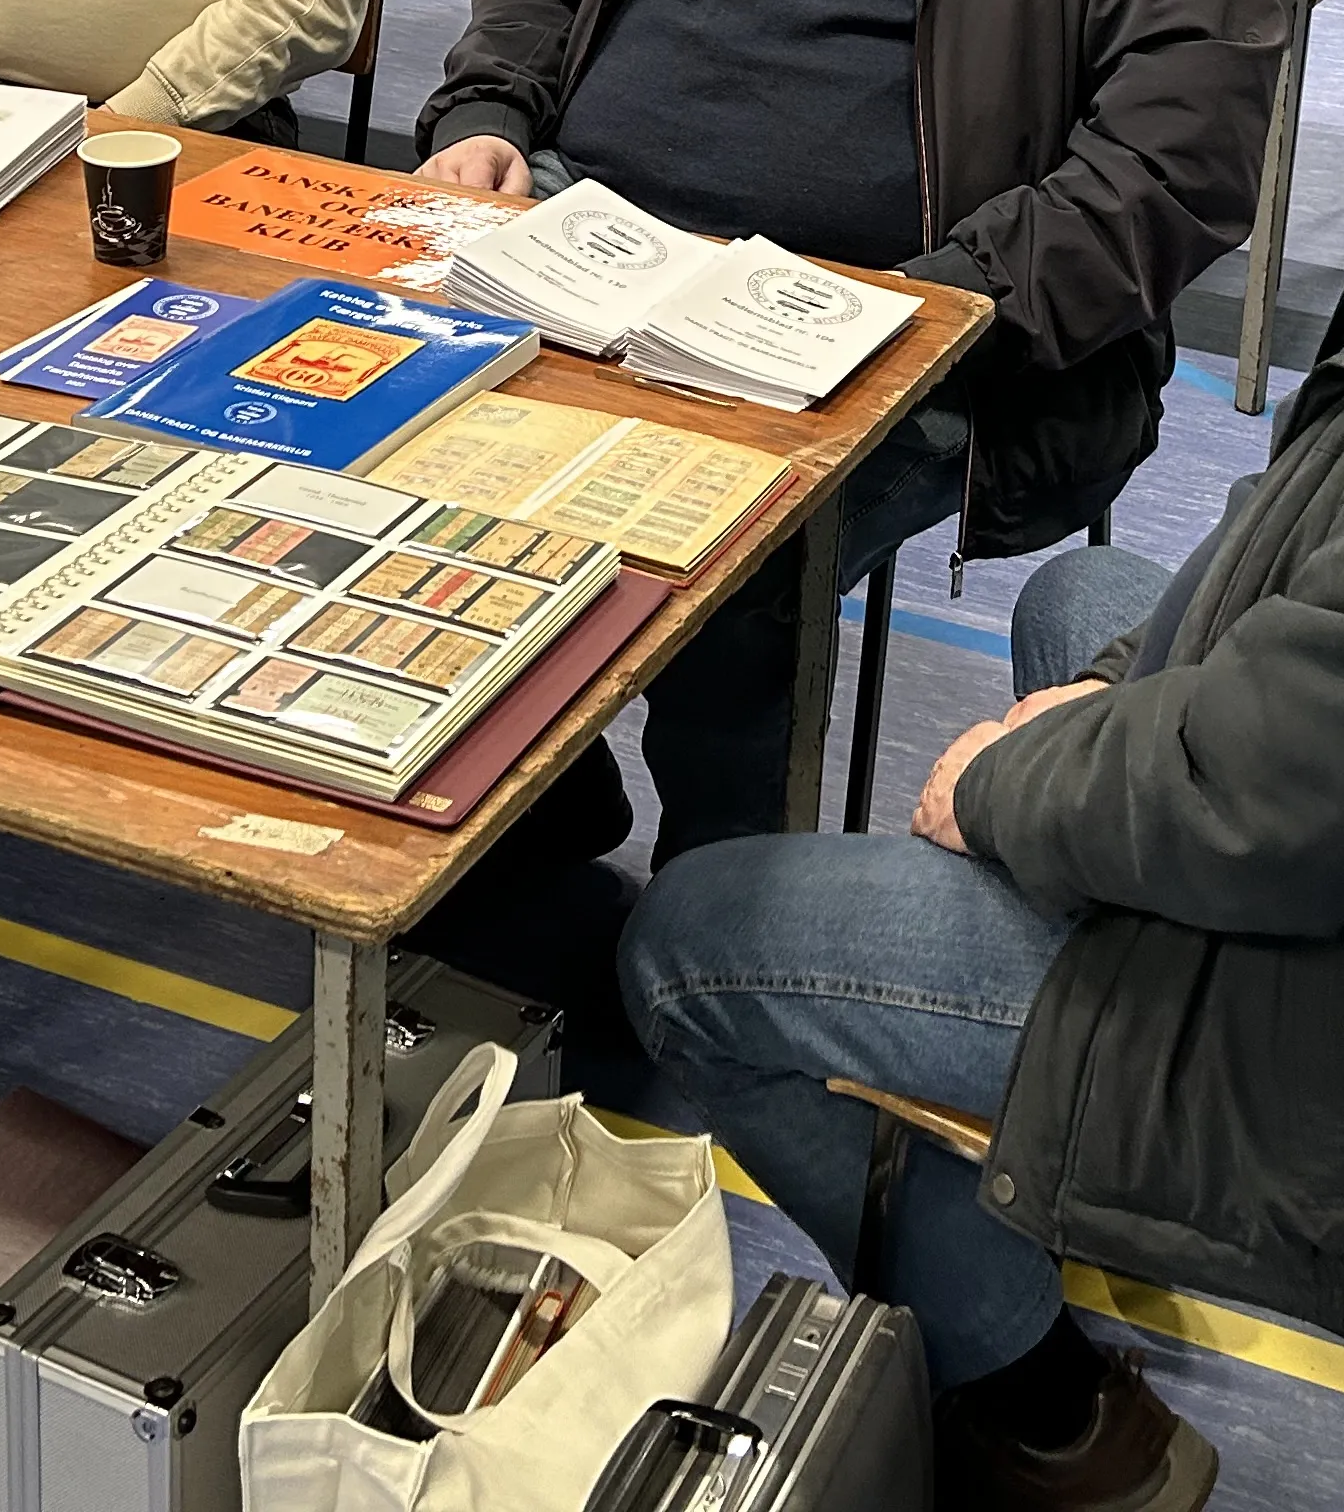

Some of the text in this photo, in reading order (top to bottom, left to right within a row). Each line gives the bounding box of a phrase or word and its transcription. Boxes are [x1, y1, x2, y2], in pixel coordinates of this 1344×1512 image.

[241, 165, 357, 199] DANSK
[244, 222, 351, 253] KLUB
[528, 233, 591, 273] Medlemsblad
[607, 278, 628, 289] 130
[320, 289, 375, 309] Katalog
[721, 296, 794, 330] Medlemsblad
[815, 333, 836, 343] 106
[67, 360, 124, 377] Danmarks
[73, 352, 141, 370] Katalog over
[285, 370, 324, 385] 60
[233, 383, 271, 398] Kristian
[124, 408, 163, 422] DANSK
[200, 428, 218, 438] OG
[218, 432, 313, 457] BANEMÆRKEKLUB
